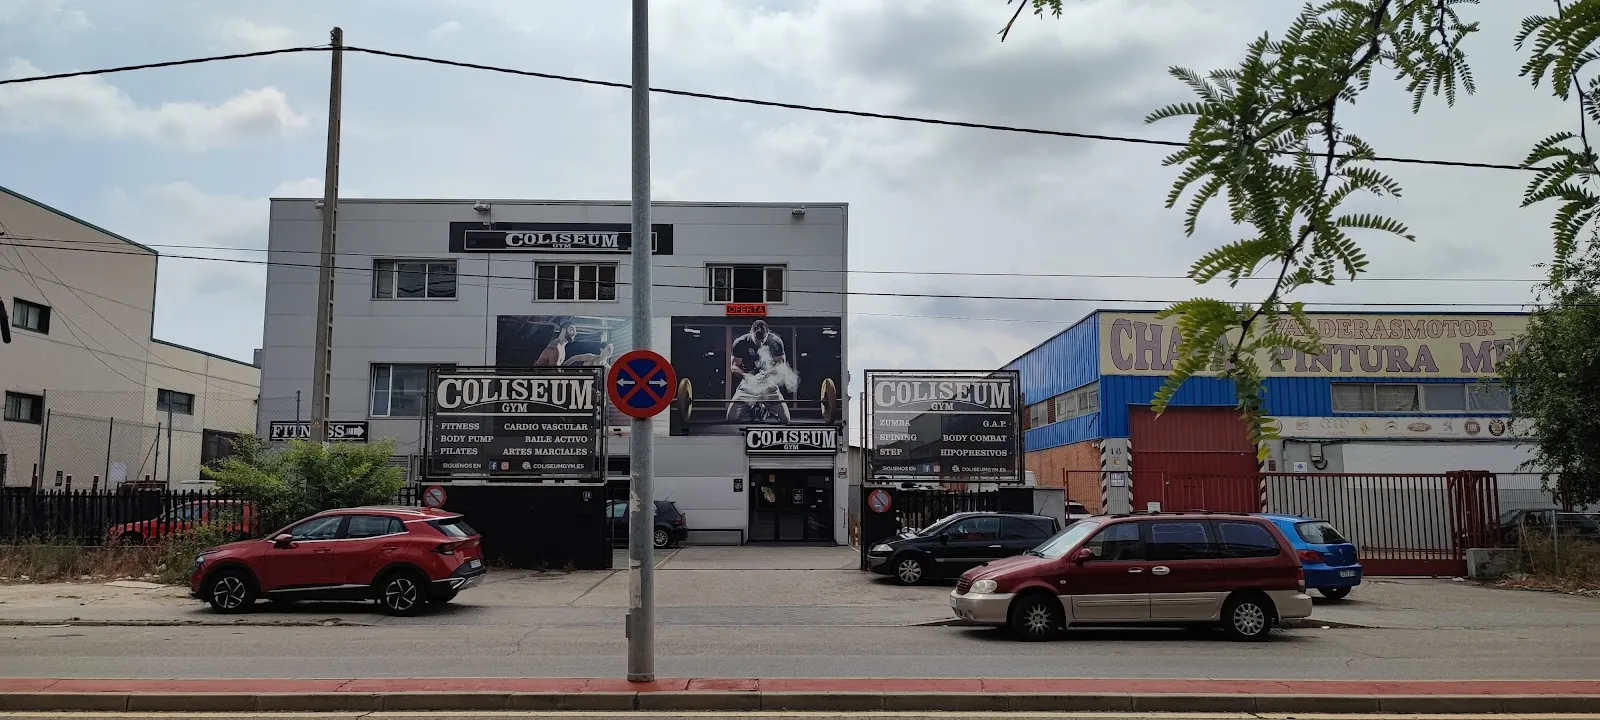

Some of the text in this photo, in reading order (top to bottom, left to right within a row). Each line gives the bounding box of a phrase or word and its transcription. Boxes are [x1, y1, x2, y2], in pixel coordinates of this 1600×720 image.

[505, 232, 619, 248] COLISEUM
[1109, 318, 1237, 372] CHAA
[1271, 342, 1439, 373] PINTURA
[437, 379, 594, 410] COLISEUM
[874, 381, 1011, 409] COLISEUM
[502, 402, 528, 412] GYM
[931, 402, 954, 411] GYM
[440, 422, 480, 430] FITNESS
[504, 423, 588, 431] CARDIO VASCULAR
[879, 419, 911, 427] ZUMBA
[982, 420, 1006, 428] G.A.P.
[271, 424, 345, 438] FITNSS
[440, 435, 494, 443] BODY PUMP
[747, 430, 836, 448] COLISEUM
[879, 433, 918, 441] SPINING
[943, 434, 1007, 442] BODY COMBAT
[439, 447, 478, 455] PILATES
[502, 448, 588, 456] ARTES MARCIALES
[879, 448, 903, 456] STEP
[940, 449, 1008, 457] HIPOPRESIVOS
[1111, 447, 1122, 455] 16
